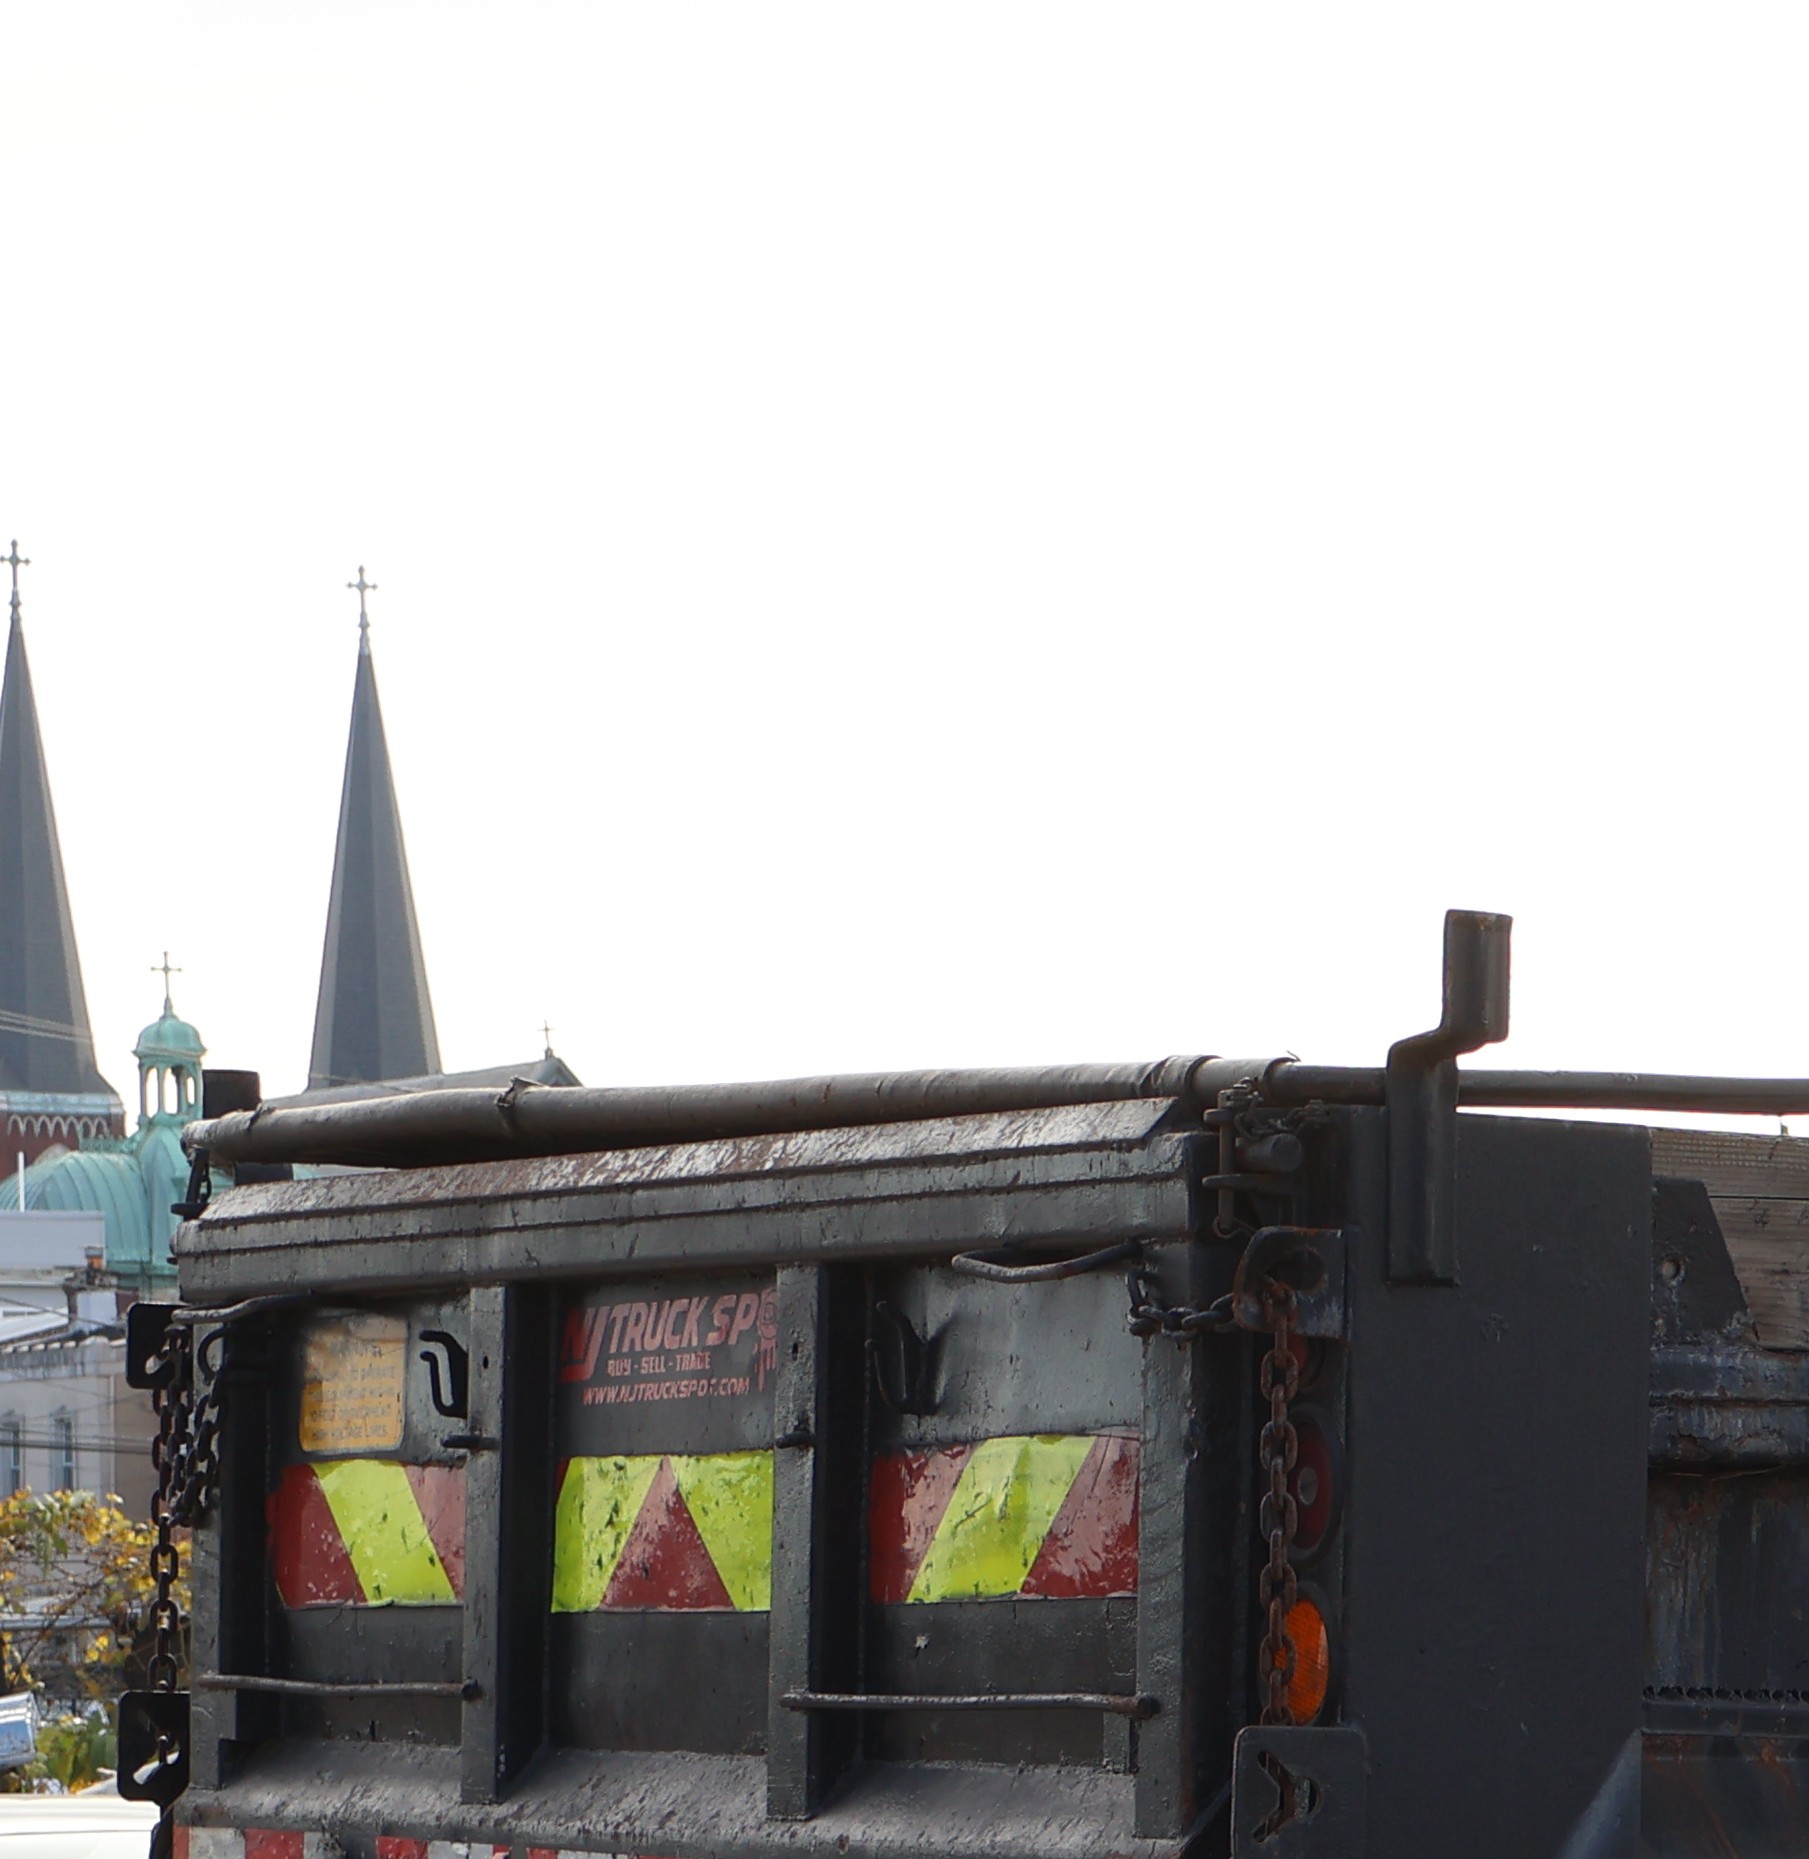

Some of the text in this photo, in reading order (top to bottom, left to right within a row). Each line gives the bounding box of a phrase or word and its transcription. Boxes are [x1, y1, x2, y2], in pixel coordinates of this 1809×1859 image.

[607, 1356, 631, 1377] BUY
[640, 1354, 666, 1375] SELL
[675, 1351, 711, 1370] TRADE
[583, 1376, 750, 1405] WWW.NJTRUCKSPOT.COM
